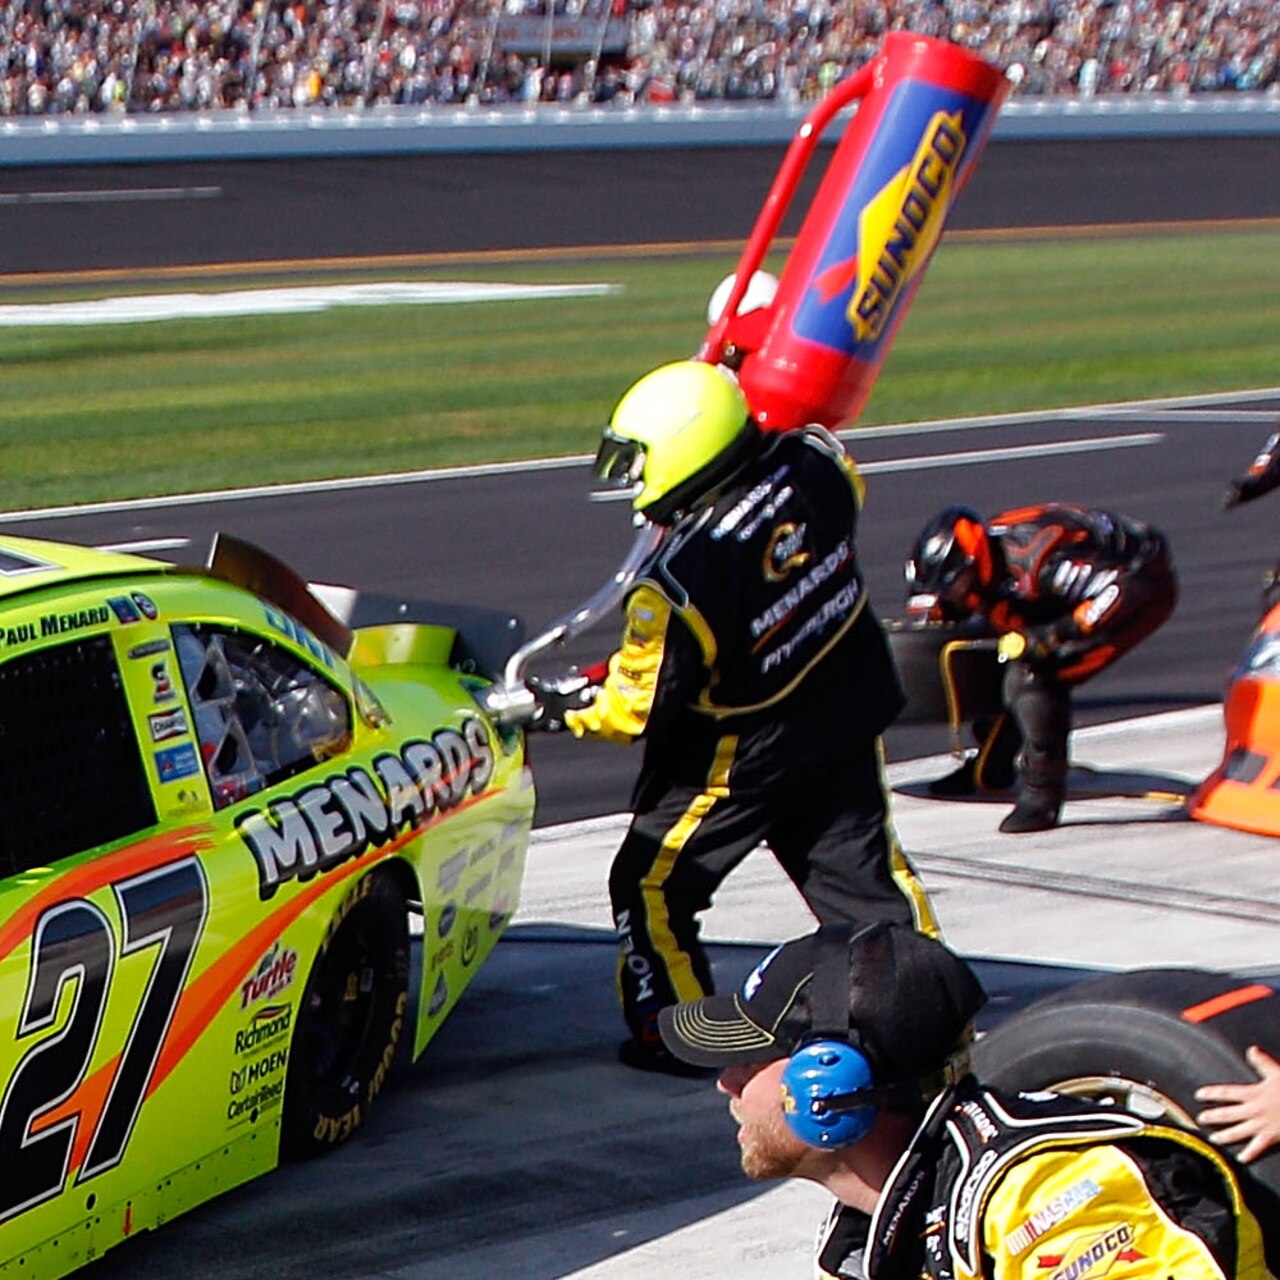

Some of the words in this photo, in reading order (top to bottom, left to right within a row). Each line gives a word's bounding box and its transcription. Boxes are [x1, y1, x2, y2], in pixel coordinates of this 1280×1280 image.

[856, 118, 960, 330] SUNOCO
[41, 607, 110, 636] MENARD
[237, 717, 495, 898] MENARDS
[241, 950, 297, 1010] Turtle
[234, 1008, 292, 1055] Richmond
[248, 1049, 287, 1085] MOEN
